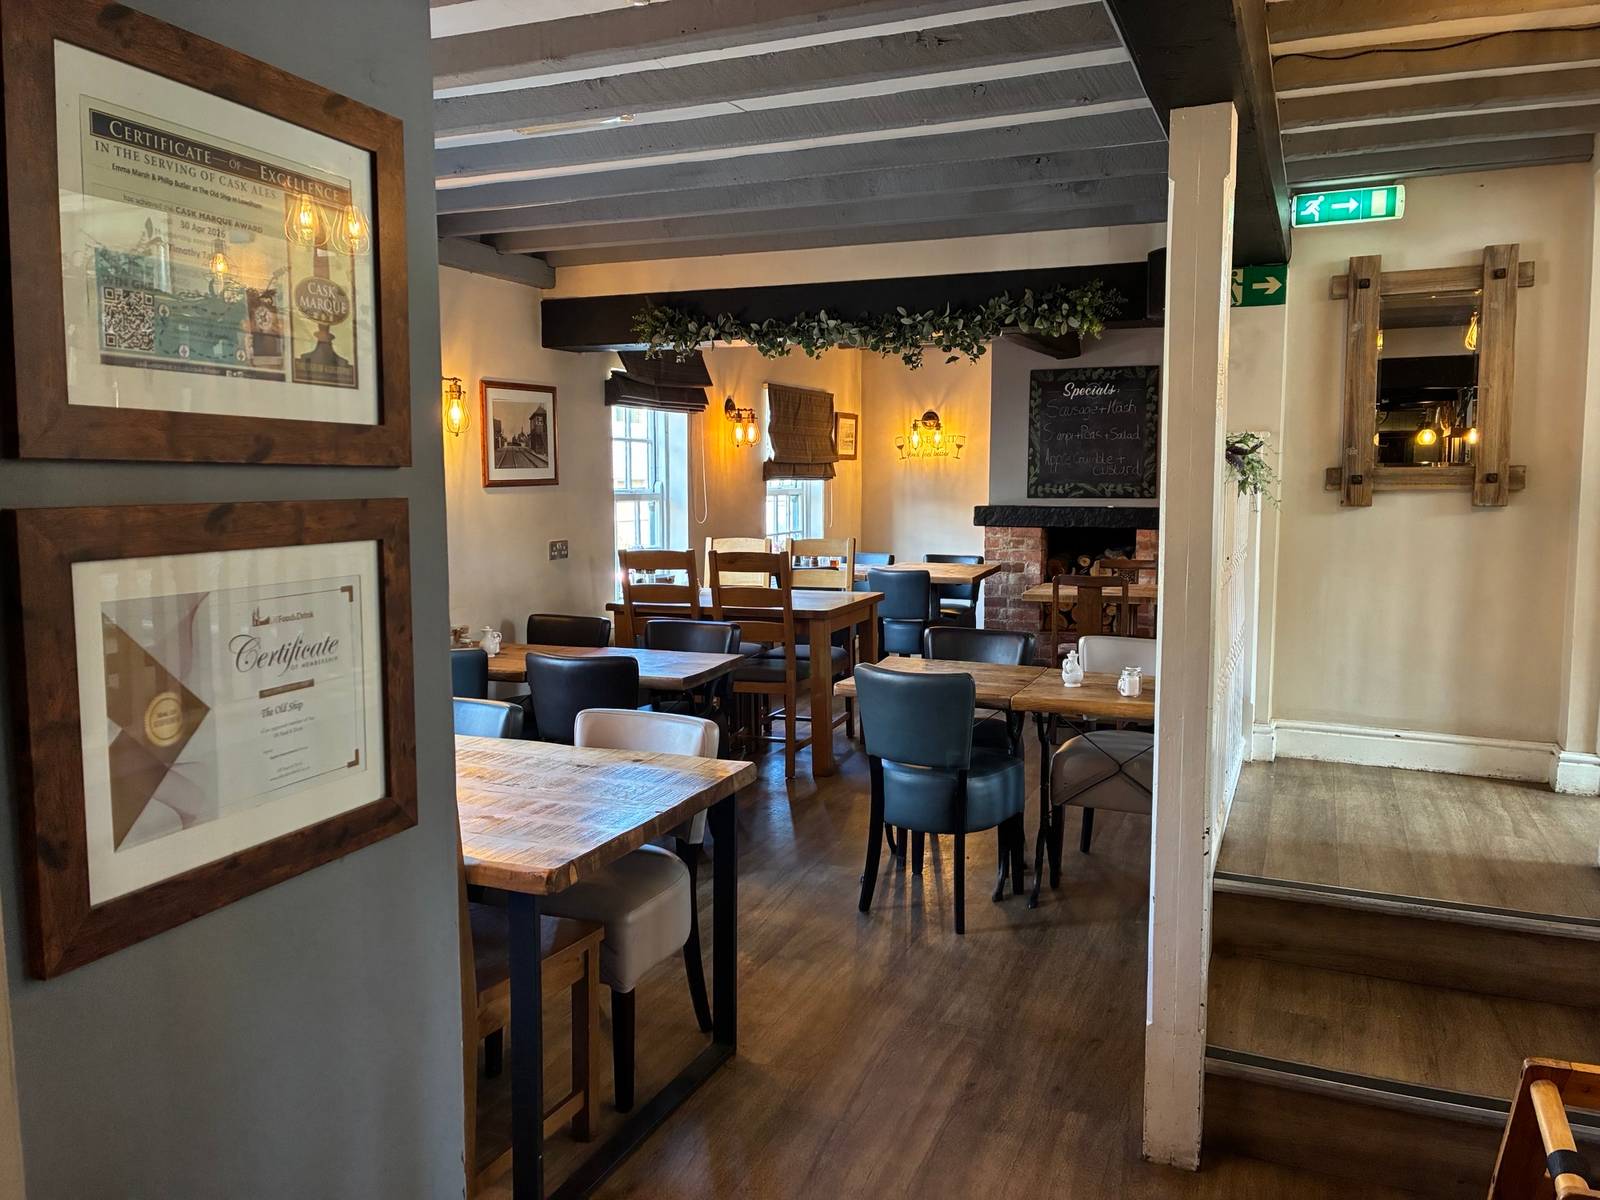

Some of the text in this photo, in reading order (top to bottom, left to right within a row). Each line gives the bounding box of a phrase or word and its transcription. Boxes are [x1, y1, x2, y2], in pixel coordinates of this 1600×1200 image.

[109, 120, 212, 164] CERTIFICATE
[95, 140, 277, 199] IN THE SERVING OF CASK ALES
[112, 163, 131, 174] Emma
[210, 190, 219, 199] Old
[175, 206, 197, 218] CASK
[199, 211, 233, 227] MARQUE
[234, 221, 263, 234] AWARD
[299, 295, 347, 314] MARQUE
[307, 281, 336, 298] CASK
[229, 632, 339, 678] Certificate
